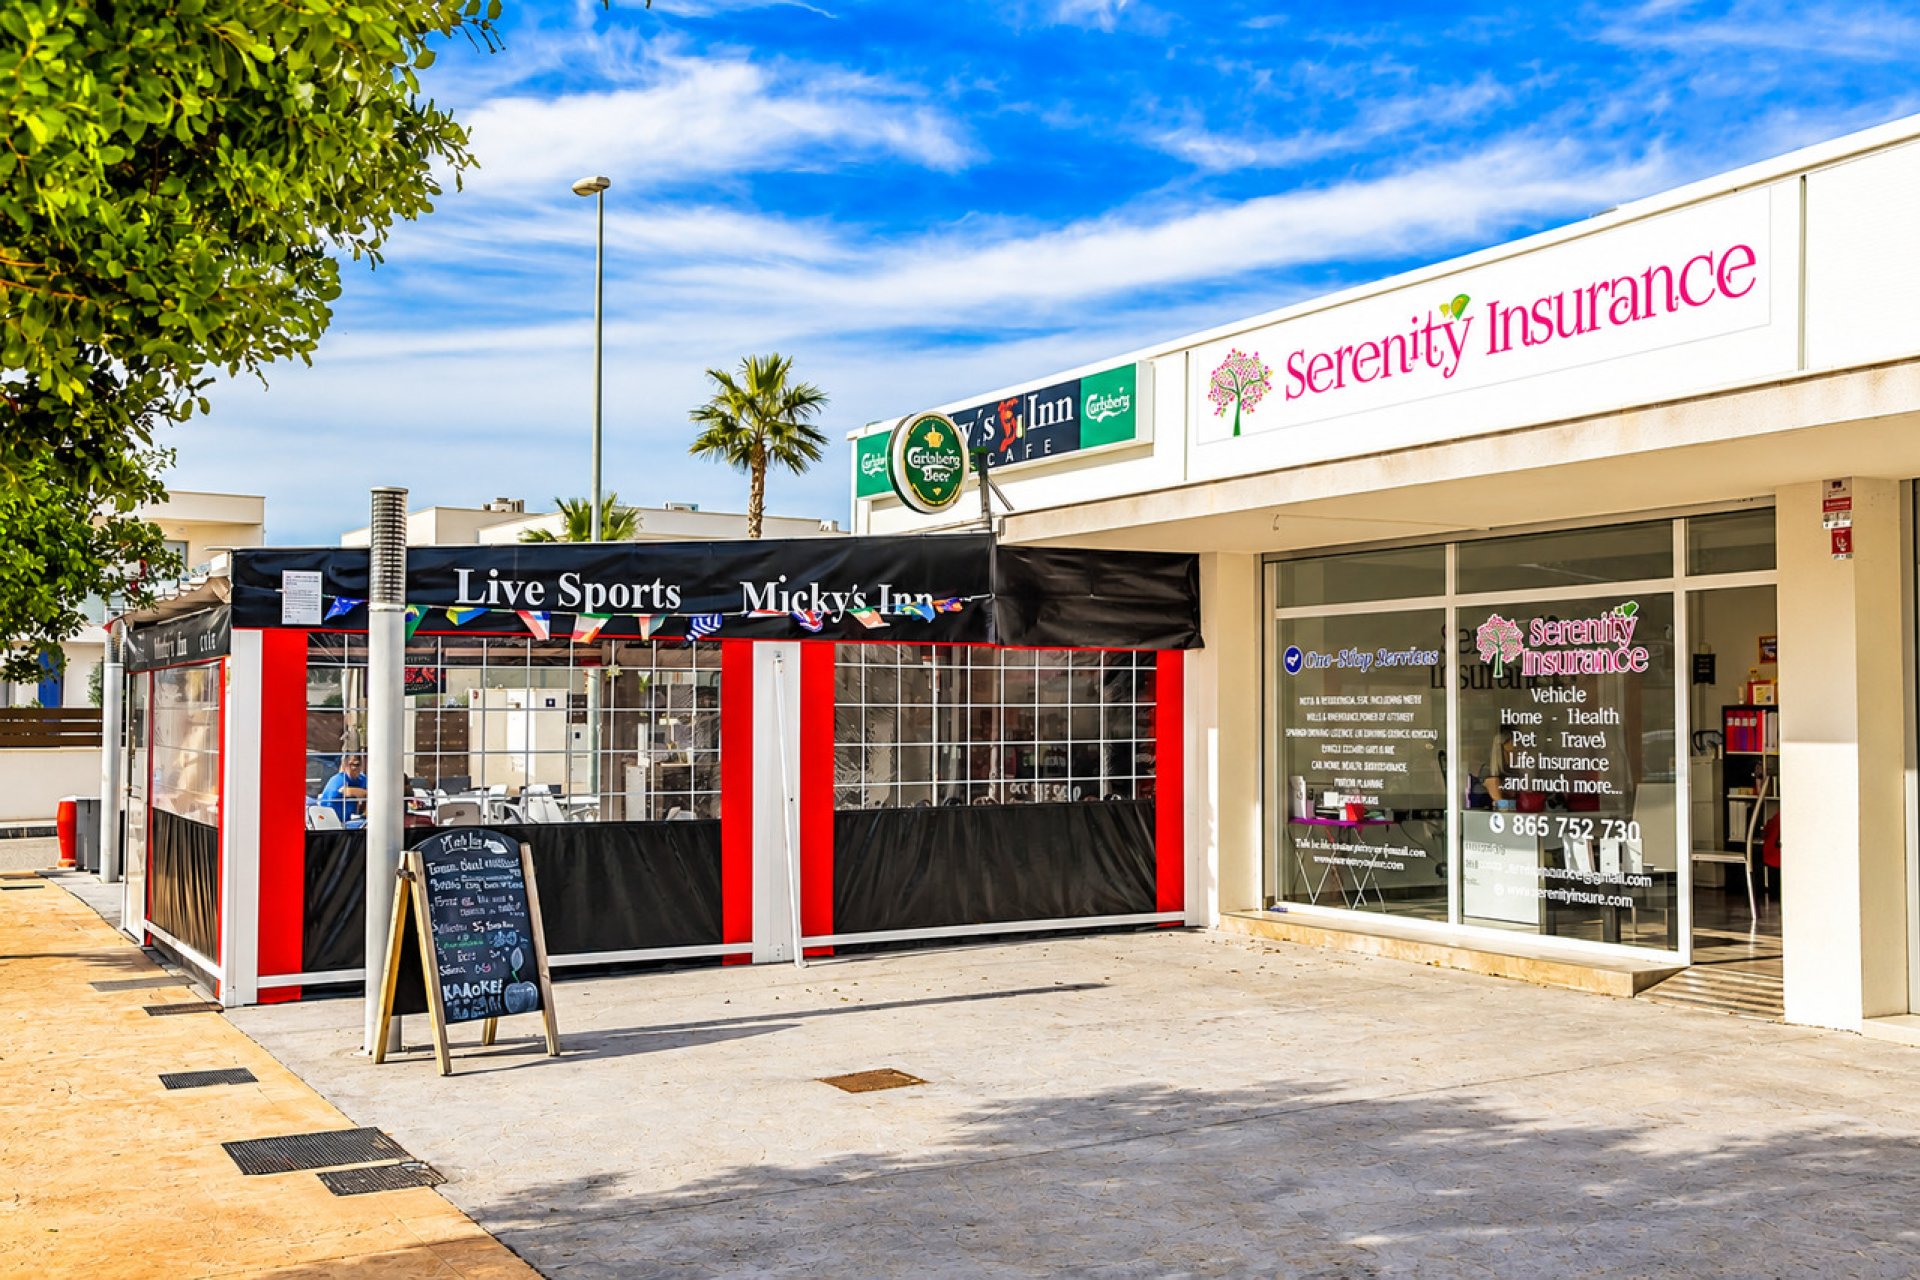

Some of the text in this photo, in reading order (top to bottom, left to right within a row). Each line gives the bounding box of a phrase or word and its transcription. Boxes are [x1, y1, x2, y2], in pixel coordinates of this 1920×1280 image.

[1286, 243, 1757, 401] Serenity Insurance
[1027, 394, 1074, 430] Inn
[1085, 387, 1130, 422] Carlsberg
[907, 446, 961, 470] Carlsberg
[921, 465, 953, 482] Beer
[453, 568, 934, 623] Live Sports Micky's Inn
[1529, 611, 1638, 648] Serenity
[1521, 647, 1649, 675] Insurance
[1531, 685, 1587, 703] Vehicle
[1501, 708, 1542, 725] Home
[1567, 707, 1620, 725] Health
[1512, 731, 1537, 747] Pet
[1561, 731, 1606, 748] Travel
[1509, 752, 1609, 772] Life Insurance
[1532, 773, 1569, 793] much
[1573, 779, 1623, 795] more...
[1512, 815, 1641, 842] 865 752 730
